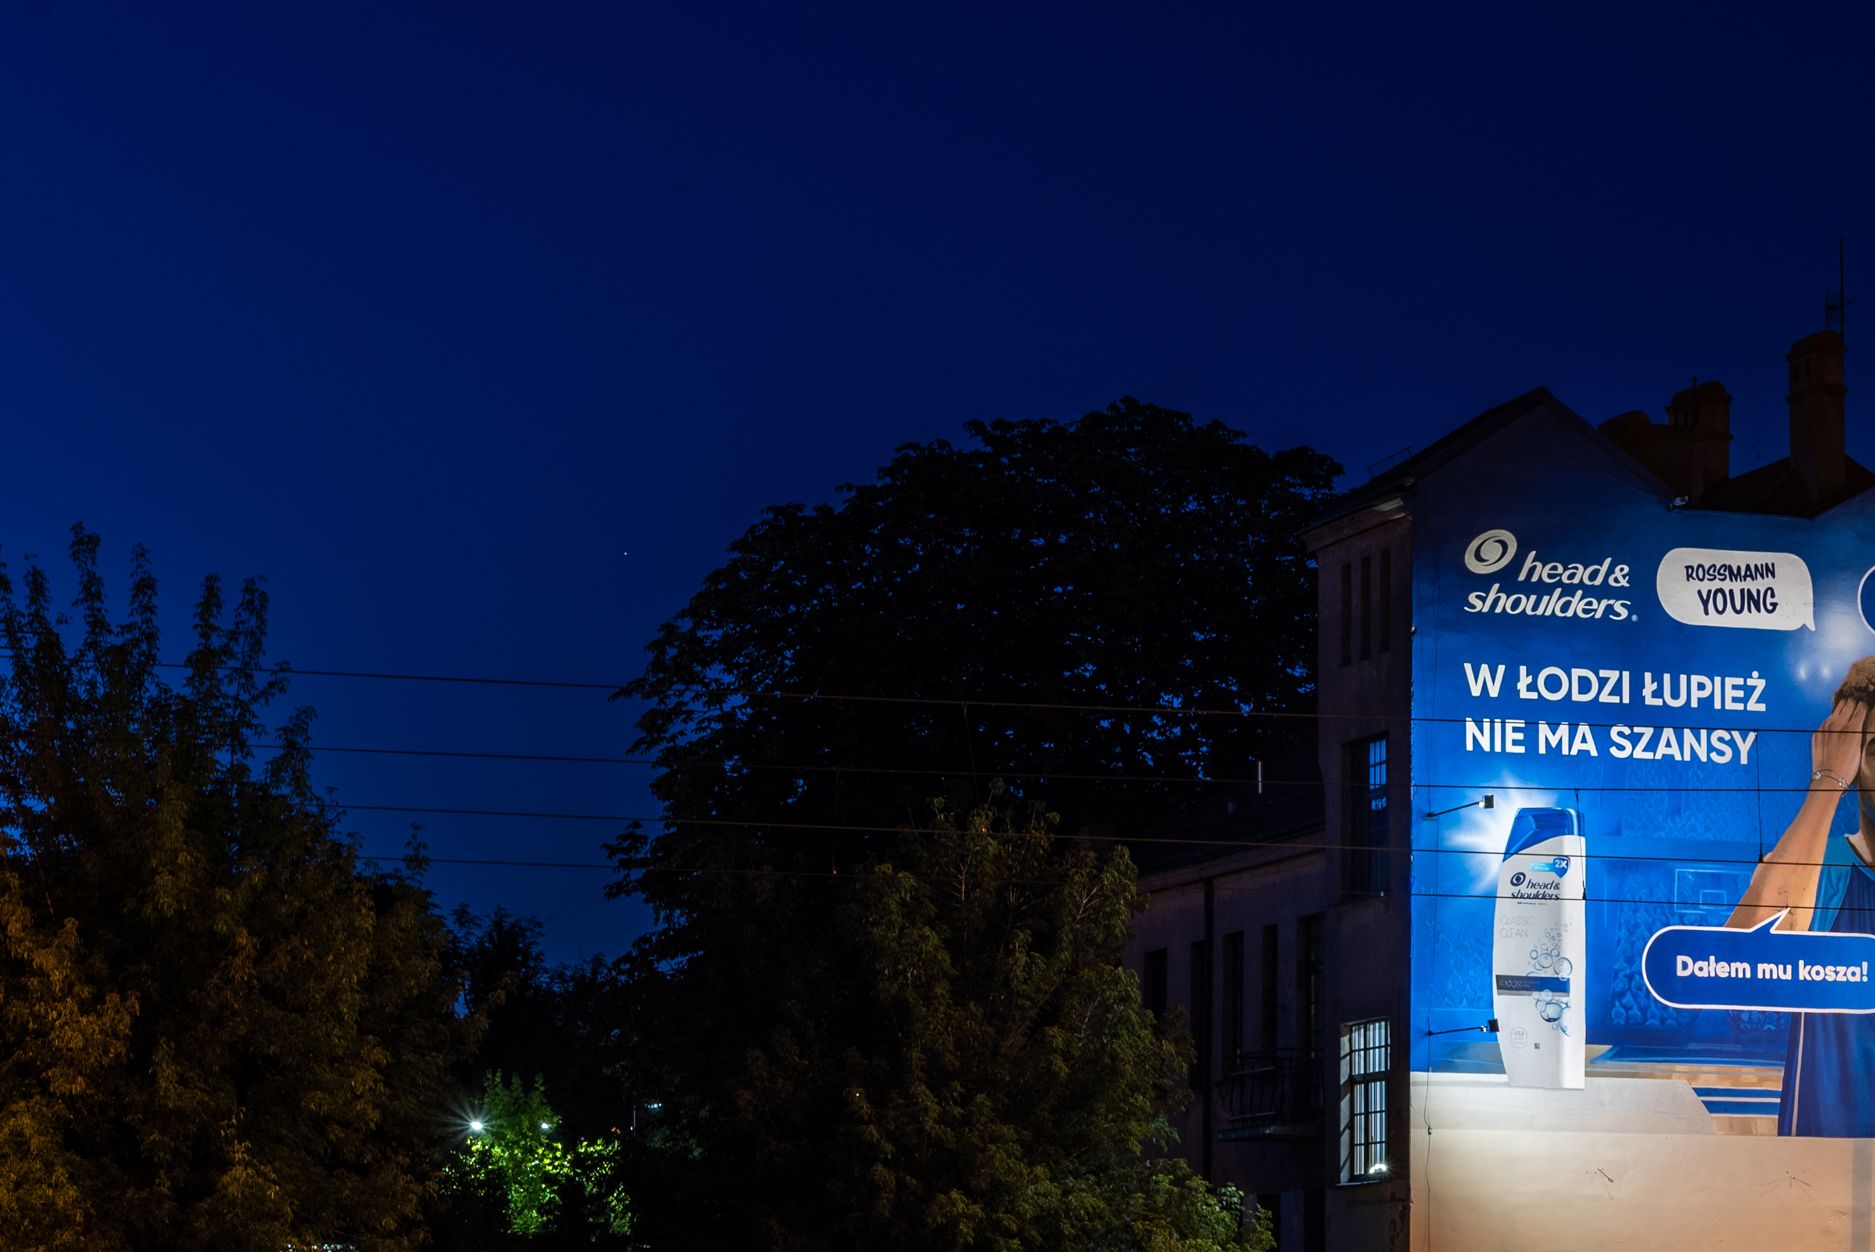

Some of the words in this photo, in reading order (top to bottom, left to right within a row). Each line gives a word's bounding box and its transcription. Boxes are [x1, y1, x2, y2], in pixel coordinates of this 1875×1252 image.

[1684, 562, 1776, 583] ROSSMANN
[1697, 586, 1779, 616] YOUNG
[1463, 662, 1506, 698] W
[1516, 665, 1630, 704] ŁODZI
[1642, 670, 1767, 712] ŁUPIEŻ
[1465, 717, 1526, 754] NIE
[1538, 721, 1598, 757] MA
[1608, 724, 1758, 765] SZANSY
[1676, 954, 1751, 981] Dałem
[1757, 958, 1793, 981] mu
[1798, 960, 1869, 983] kosza!
